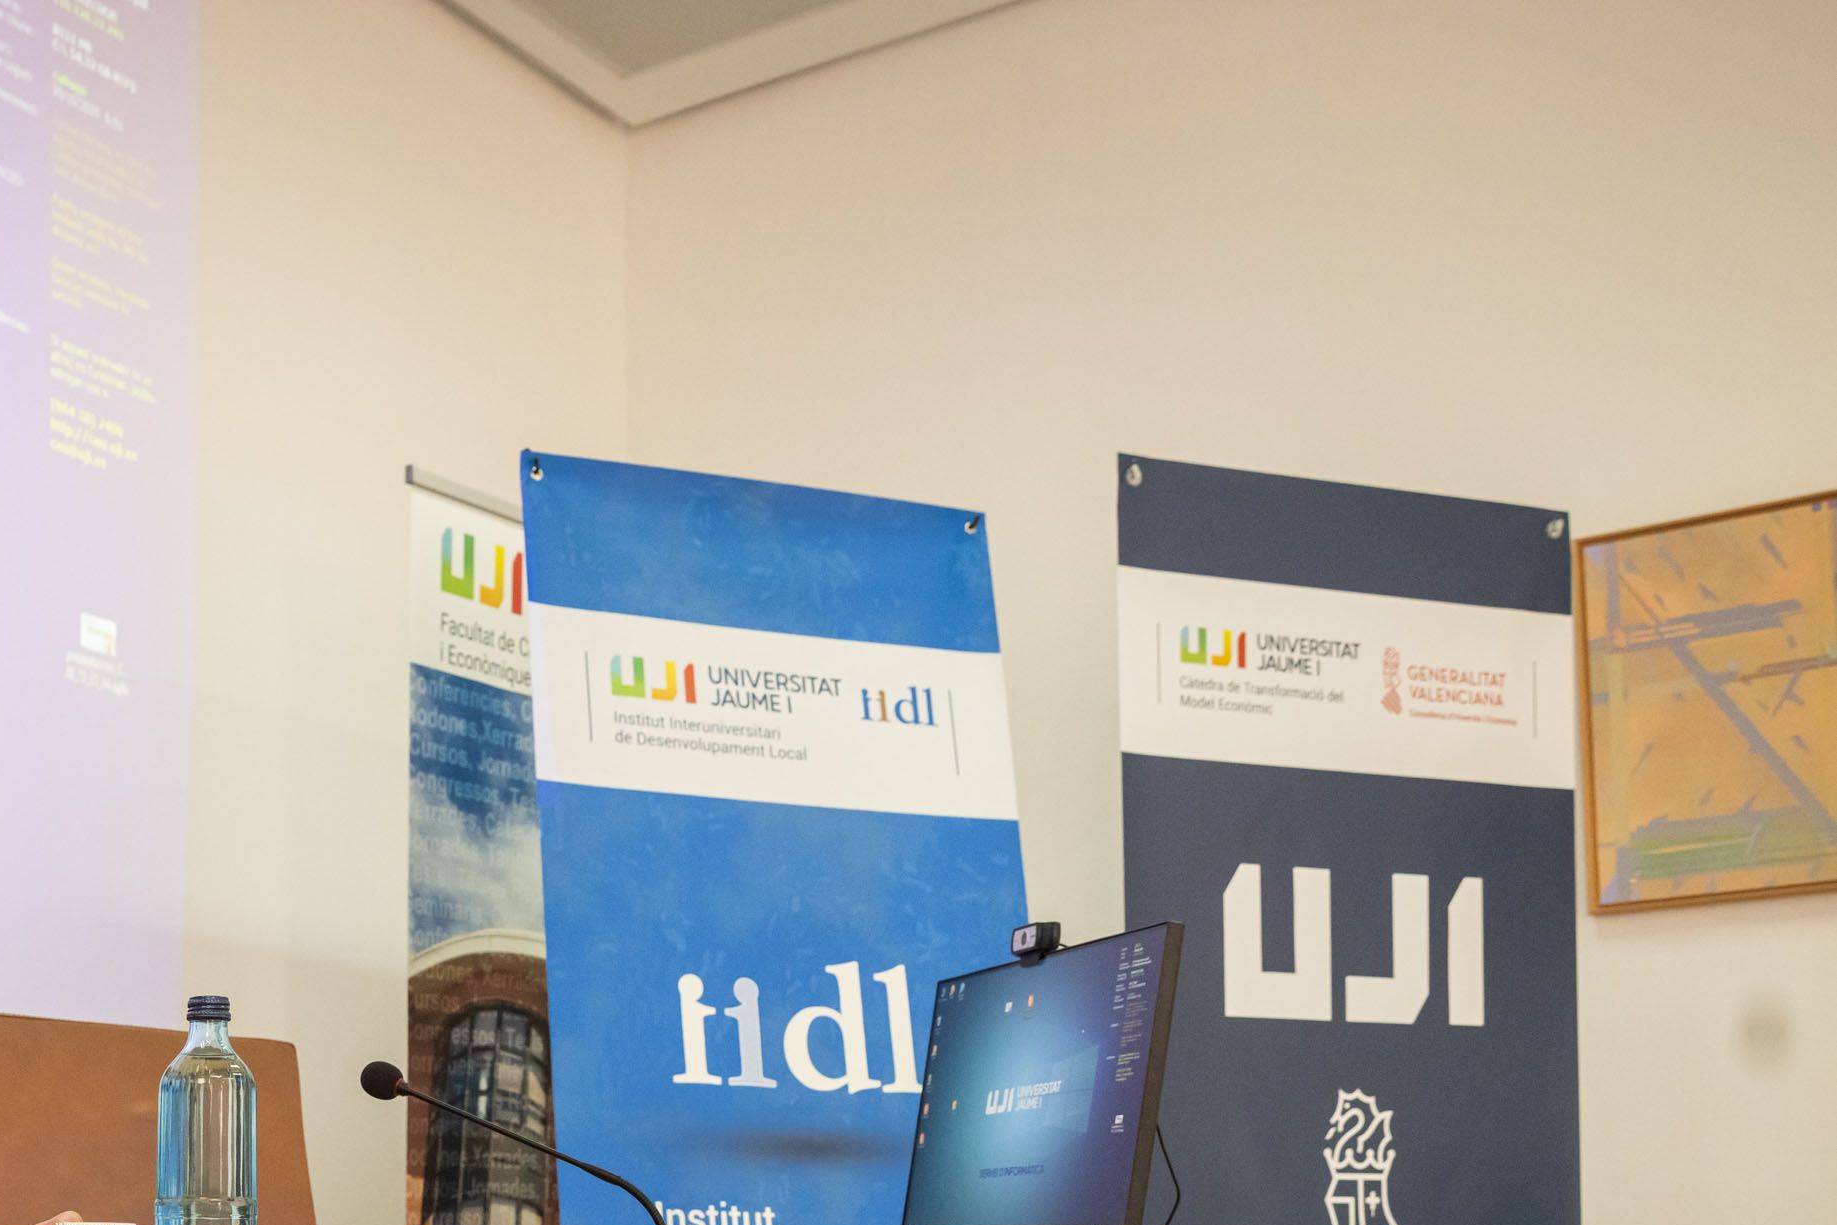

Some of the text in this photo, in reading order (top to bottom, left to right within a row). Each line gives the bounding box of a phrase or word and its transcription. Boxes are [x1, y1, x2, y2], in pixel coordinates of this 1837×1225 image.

[441, 527, 523, 616] UJI
[440, 612, 495, 648] Facultat
[498, 632, 515, 655] de
[1180, 624, 1247, 669] UJI
[1256, 633, 1360, 660] UNIVERSITAT
[611, 654, 697, 705] UJI
[1257, 654, 1321, 676] JAUME I
[1407, 664, 1506, 688] GENERALITAT
[708, 665, 843, 697] UNIVERSITAT
[1227, 680, 1241, 693] de
[1244, 681, 1325, 702] Transformació
[1327, 690, 1344, 704] del
[1410, 685, 1505, 707] VALENCIANA
[711, 686, 793, 714] JAUME I
[1179, 695, 1215, 710] Model
[614, 711, 782, 742] Institut Interuniversitari
[615, 731, 808, 761] de Desenvolupament Local
[1223, 862, 1485, 1027] UJI
